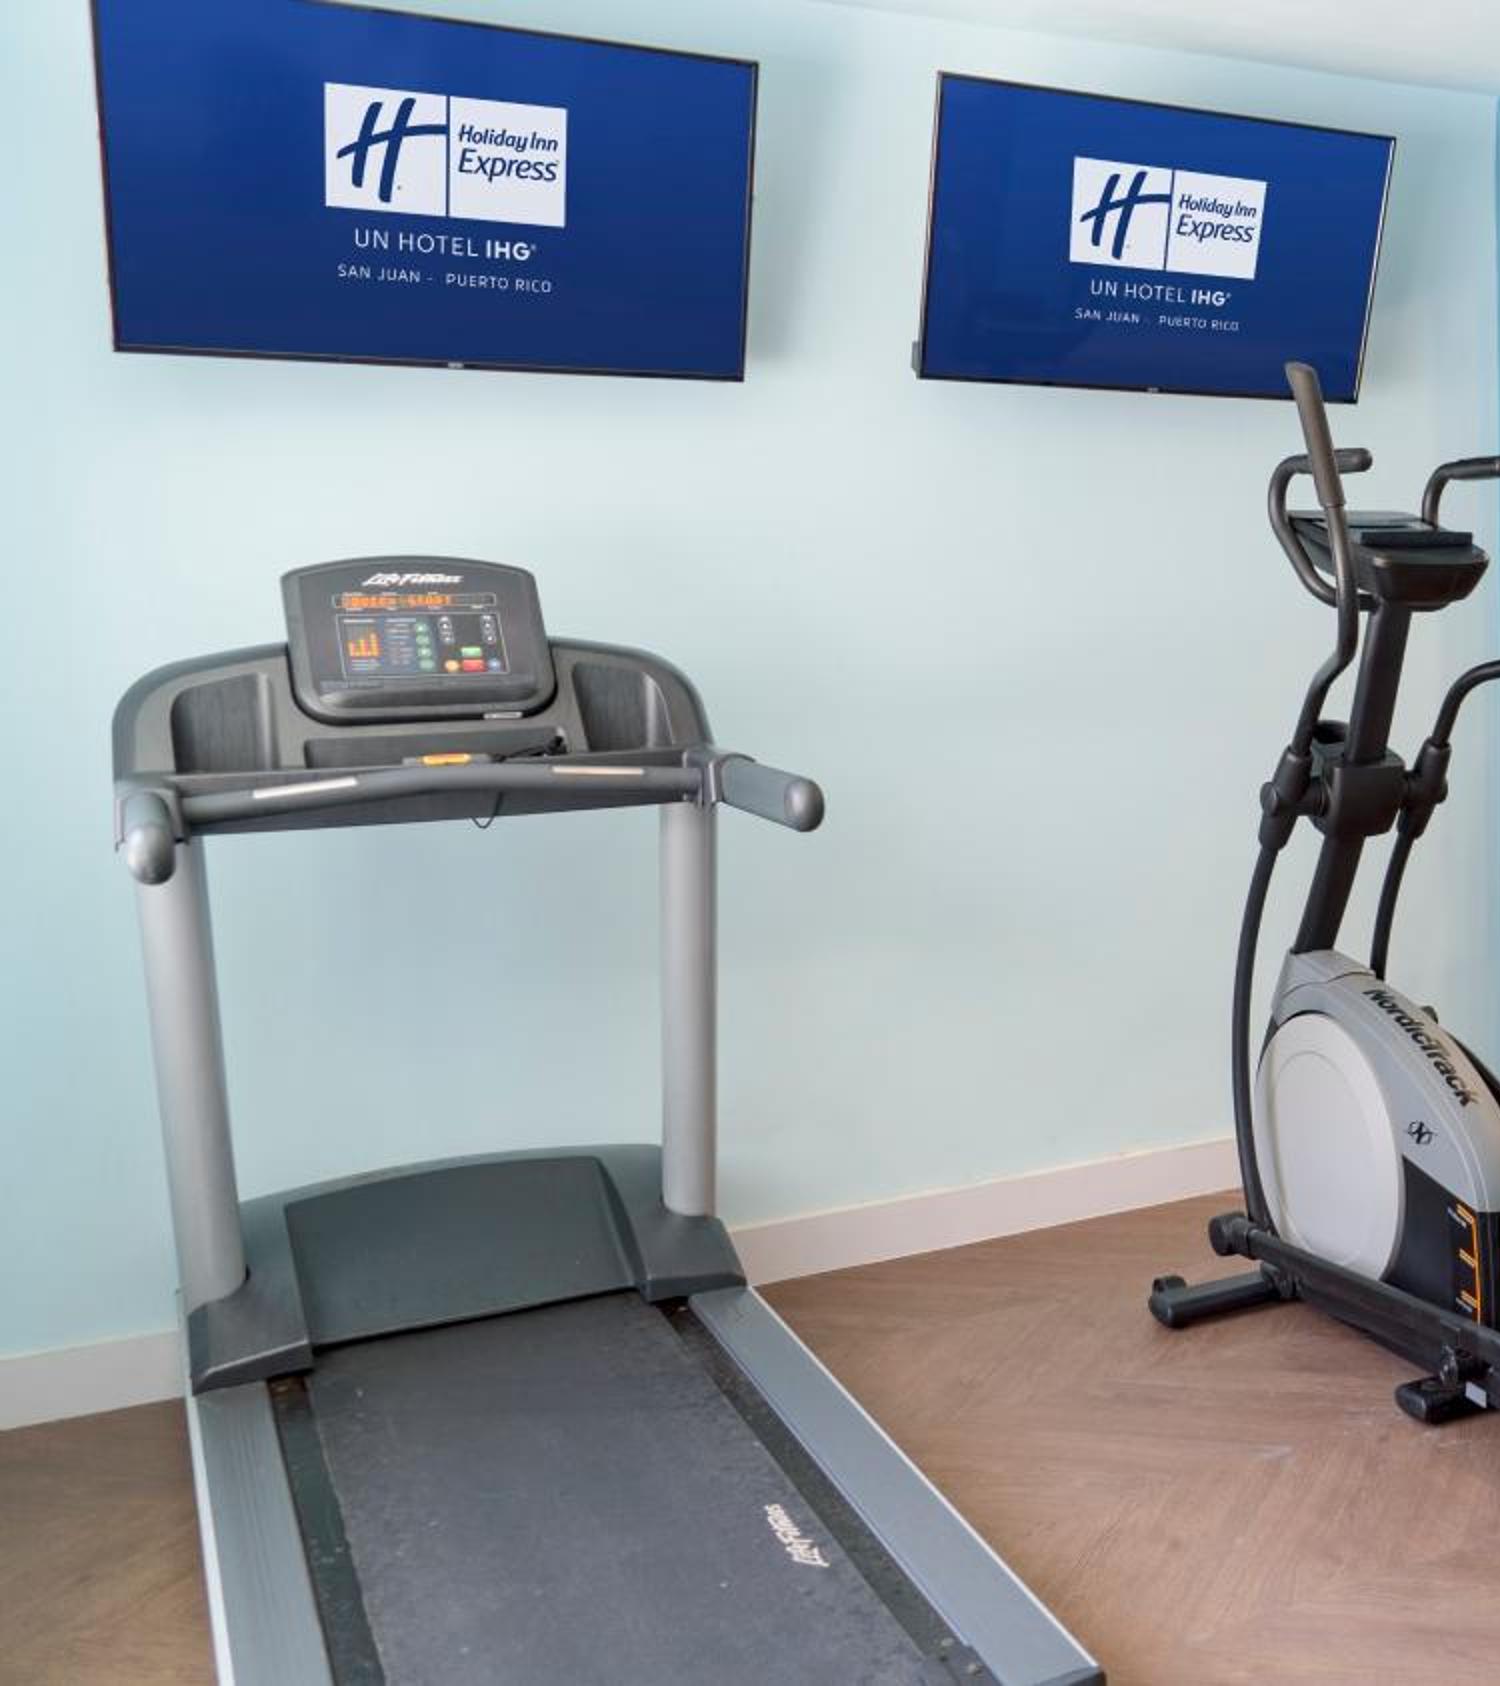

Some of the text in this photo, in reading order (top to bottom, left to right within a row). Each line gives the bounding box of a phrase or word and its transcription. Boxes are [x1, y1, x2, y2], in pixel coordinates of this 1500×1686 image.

[458, 123, 559, 152] Holiday Inn
[457, 148, 558, 183] Express
[1178, 193, 1257, 219] Holiday Inn
[354, 227, 389, 250] UN
[399, 231, 479, 257] HOTEL
[1176, 213, 1255, 243] Express
[337, 263, 371, 280] SAN
[377, 268, 421, 283] JUAN
[445, 273, 509, 290] PUERTO
[515, 278, 552, 293] RICO
[1090, 278, 1118, 298] UN
[1125, 283, 1186, 304] HOTEL
[1074, 307, 1239, 332] SAN JUAN PUERTO RICO
[1362, 989, 1479, 1107] NordicTrack
